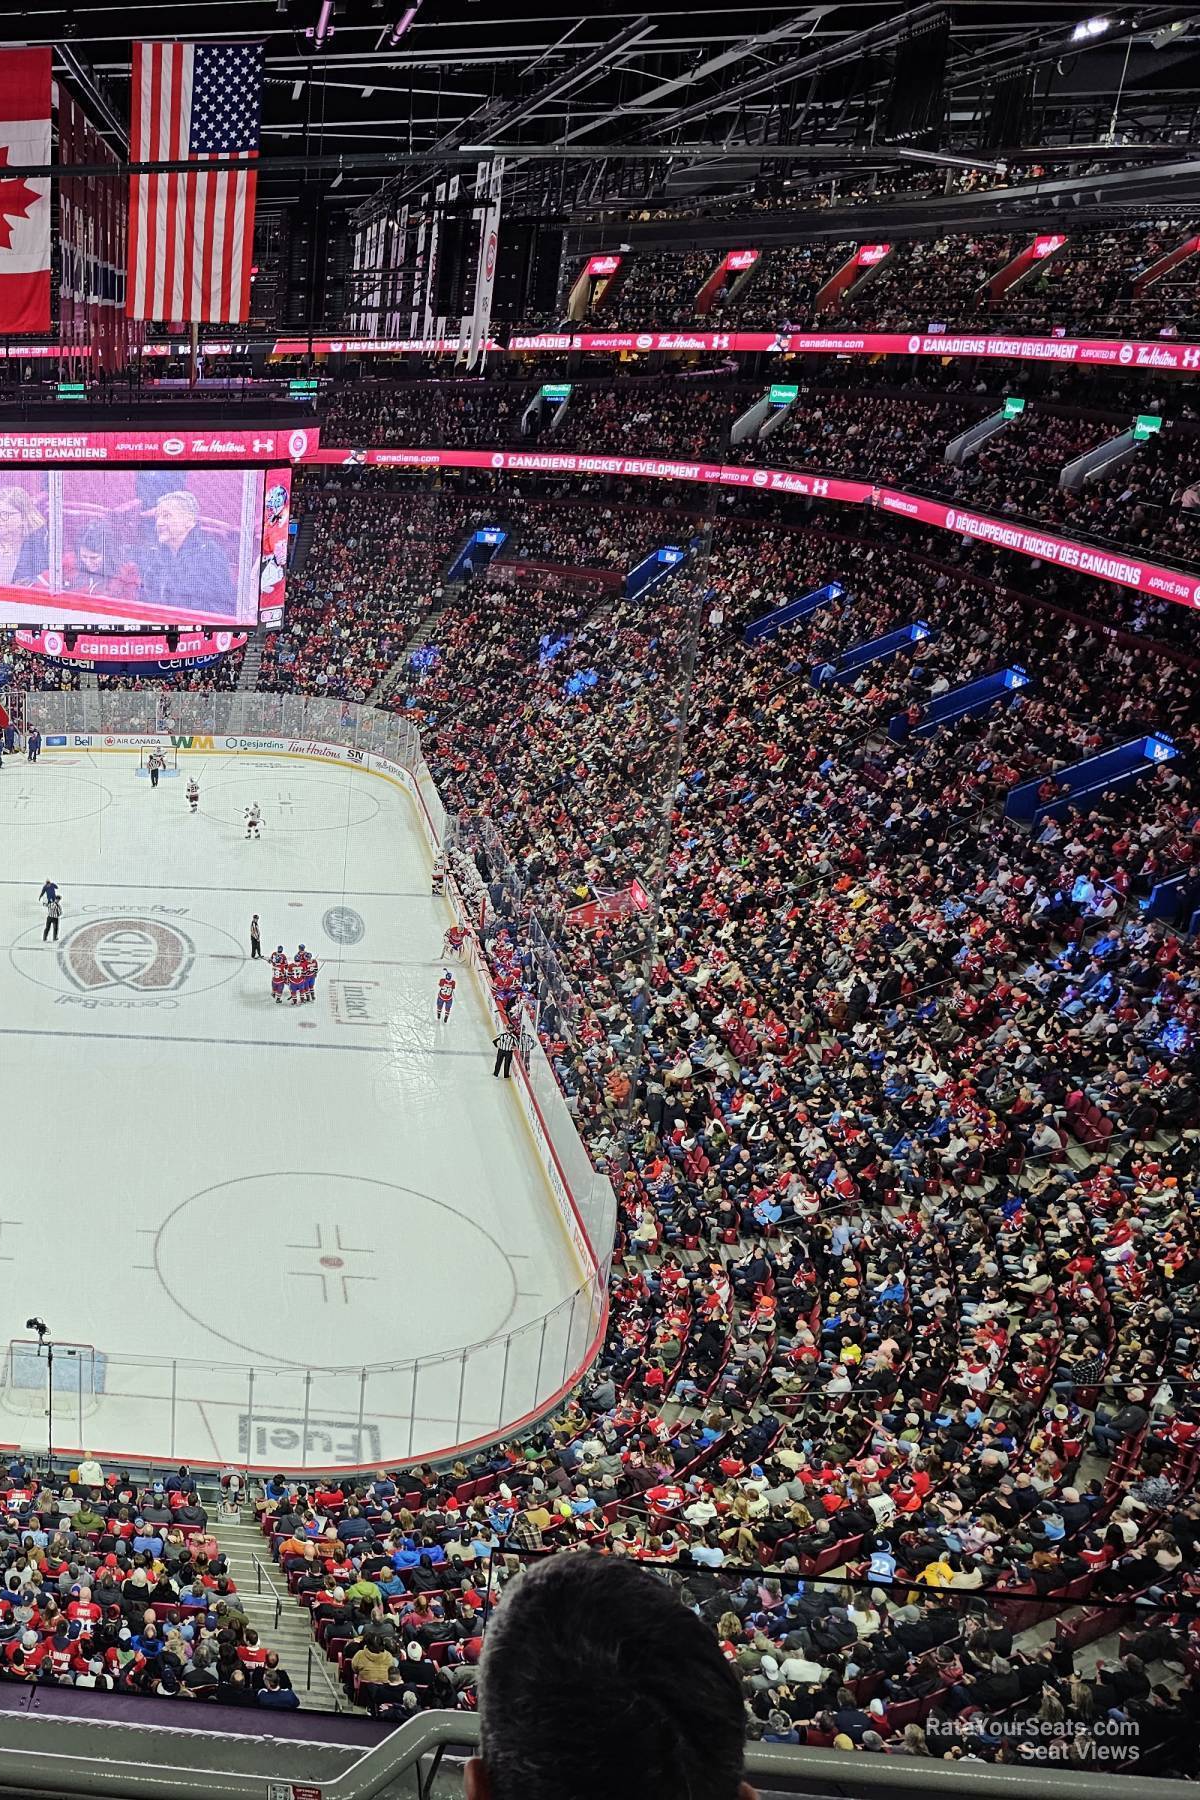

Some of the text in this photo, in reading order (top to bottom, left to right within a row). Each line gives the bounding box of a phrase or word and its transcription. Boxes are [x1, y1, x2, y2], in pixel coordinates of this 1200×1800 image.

[616, 338, 632, 347] PAR
[800, 338, 864, 349] canadiens.com
[923, 339, 1079, 359] CANADIENS HOCKEY DEVELOPMENT
[1081, 349, 1116, 359] SUPPORTED BY
[115, 441, 159, 451] APPUYÉ PAR
[191, 438, 246, 453] Tim Hortons
[22, 447, 43, 459] DES
[44, 447, 107, 458] CANADIENS
[376, 453, 440, 463] canadiens.com
[508, 456, 700, 478] CANADIENS HOCKEY DEVELOPMENT
[704, 471, 749, 482] SUPPORTED BY
[771, 474, 784, 489] Tim
[956, 513, 1142, 585] DÉVELOPPEMENT HOCKEY DES CANADIENS
[1148, 576, 1190, 598] APPUYÉ PAR
[80, 638, 201, 656] canadiens.om
[74, 735, 93, 747] Bell
[116, 737, 161, 746] AIR CANADA
[170, 735, 215, 749] WM
[240, 738, 284, 750] Desjardins
[288, 740, 341, 760] Tim Hortons
[347, 749, 364, 761] SN
[1154, 744, 1169, 761] Bell
[81, 903, 190, 916] CentreBell
[343, 984, 370, 1021] intact
[872, 1559, 889, 1570] 22
